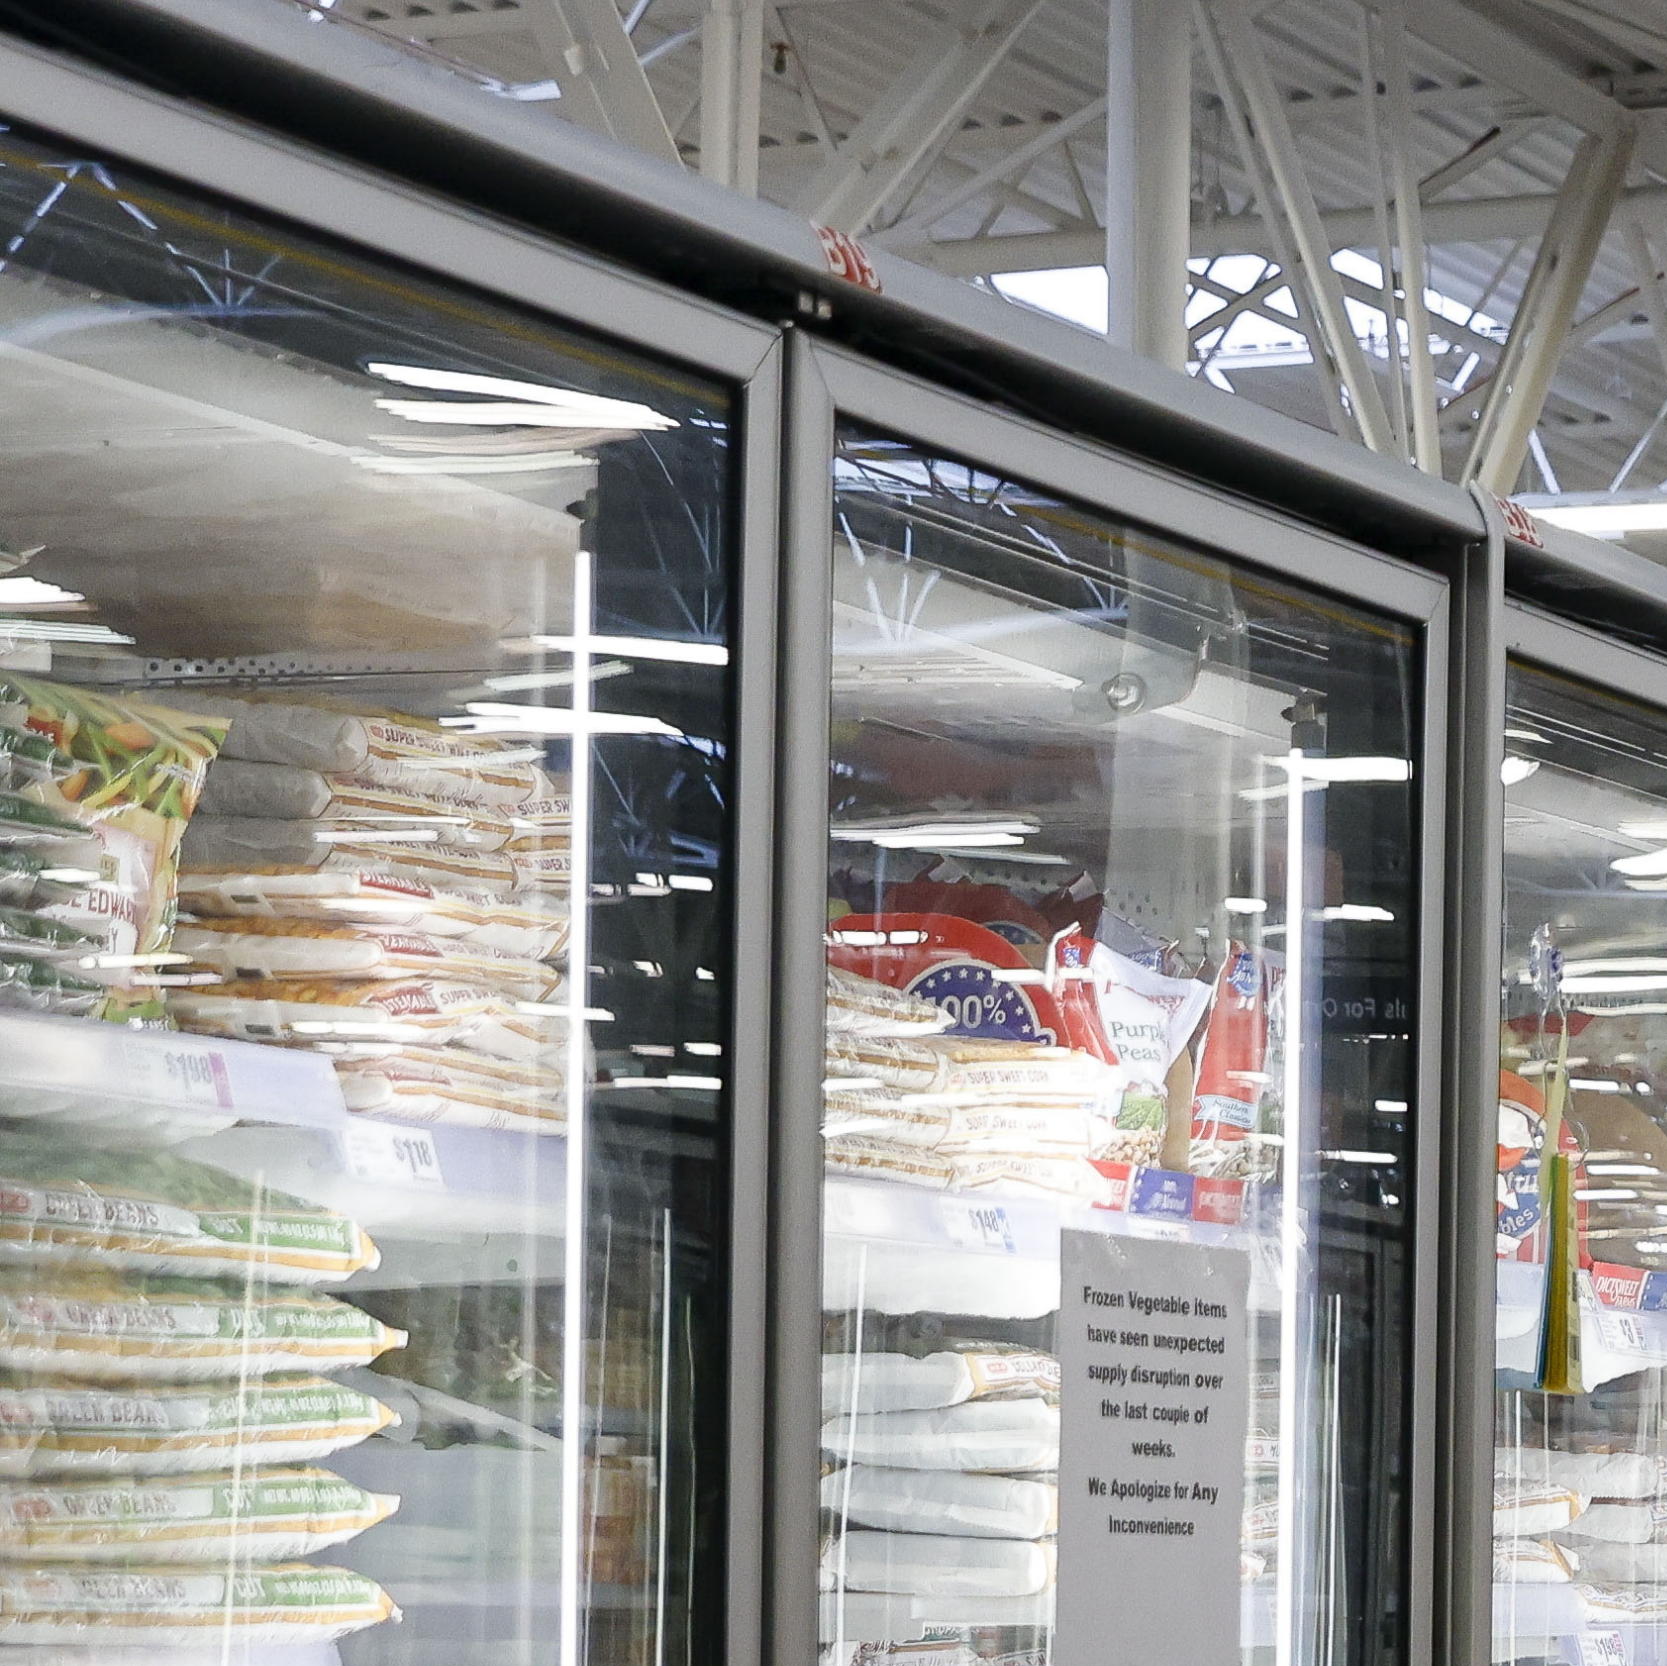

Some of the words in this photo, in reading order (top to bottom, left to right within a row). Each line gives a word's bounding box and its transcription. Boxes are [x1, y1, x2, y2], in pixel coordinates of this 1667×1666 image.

[1083, 1286, 1124, 1306] Frozen
[1128, 1291, 1190, 1316] Vegetable
[1194, 1297, 1228, 1319] Items
[1087, 1325, 1117, 1344] have
[1120, 1331, 1149, 1347] seen
[1153, 1333, 1226, 1354] unexpected
[1088, 1364, 1128, 1386] supply
[1130, 1365, 1190, 1388] disruption
[1194, 1373, 1224, 1390] over
[1101, 1399, 1121, 1417] the
[1125, 1401, 1148, 1420] last
[1153, 1404, 1190, 1425] couple
[1194, 1406, 1210, 1424] of
[1131, 1439, 1176, 1458] weeks.
[1088, 1477, 1107, 1496] We
[1110, 1478, 1172, 1501] Apologize
[1173, 1481, 1189, 1499] for
[1191, 1482, 1219, 1505] Any
[1108, 1515, 1194, 1535] Inconvenience
